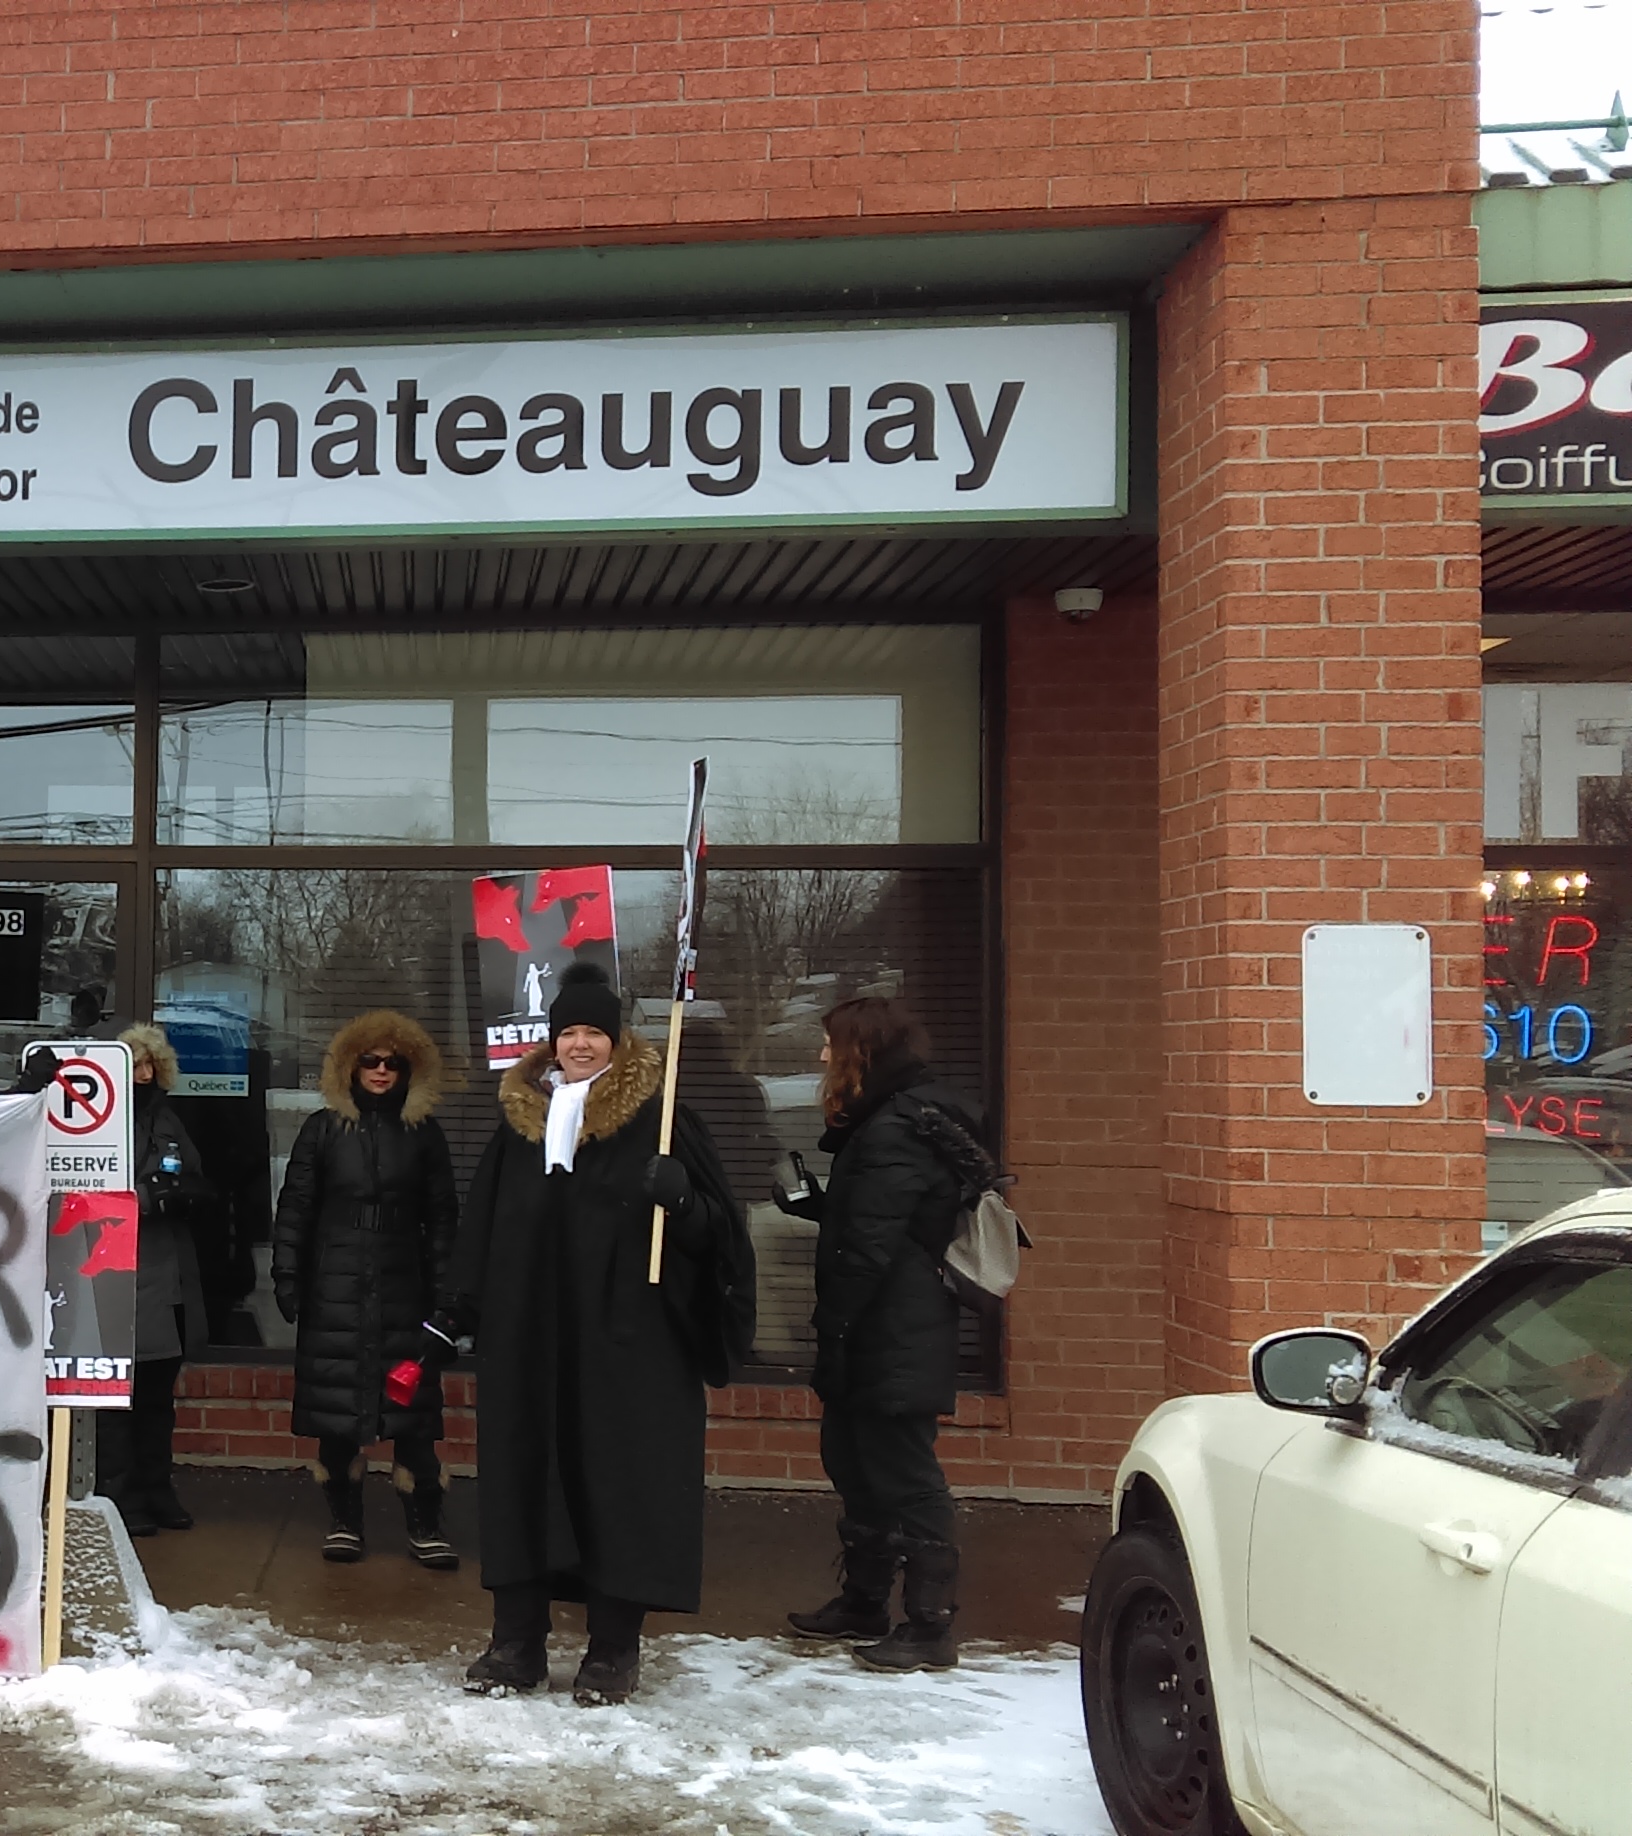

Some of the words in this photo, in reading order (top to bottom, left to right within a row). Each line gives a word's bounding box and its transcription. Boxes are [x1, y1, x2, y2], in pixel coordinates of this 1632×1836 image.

[126, 366, 1026, 497] Châteauguay
[1480, 444, 1632, 491] oiffu
[486, 1023, 550, 1046] L'ÉTA
[188, 1079, 229, 1092] Québec
[46, 1152, 119, 1172] ÉSERVÉ
[51, 1178, 90, 1188] BUREAU
[92, 1178, 106, 1188] DE
[76, 1357, 132, 1380] EST
